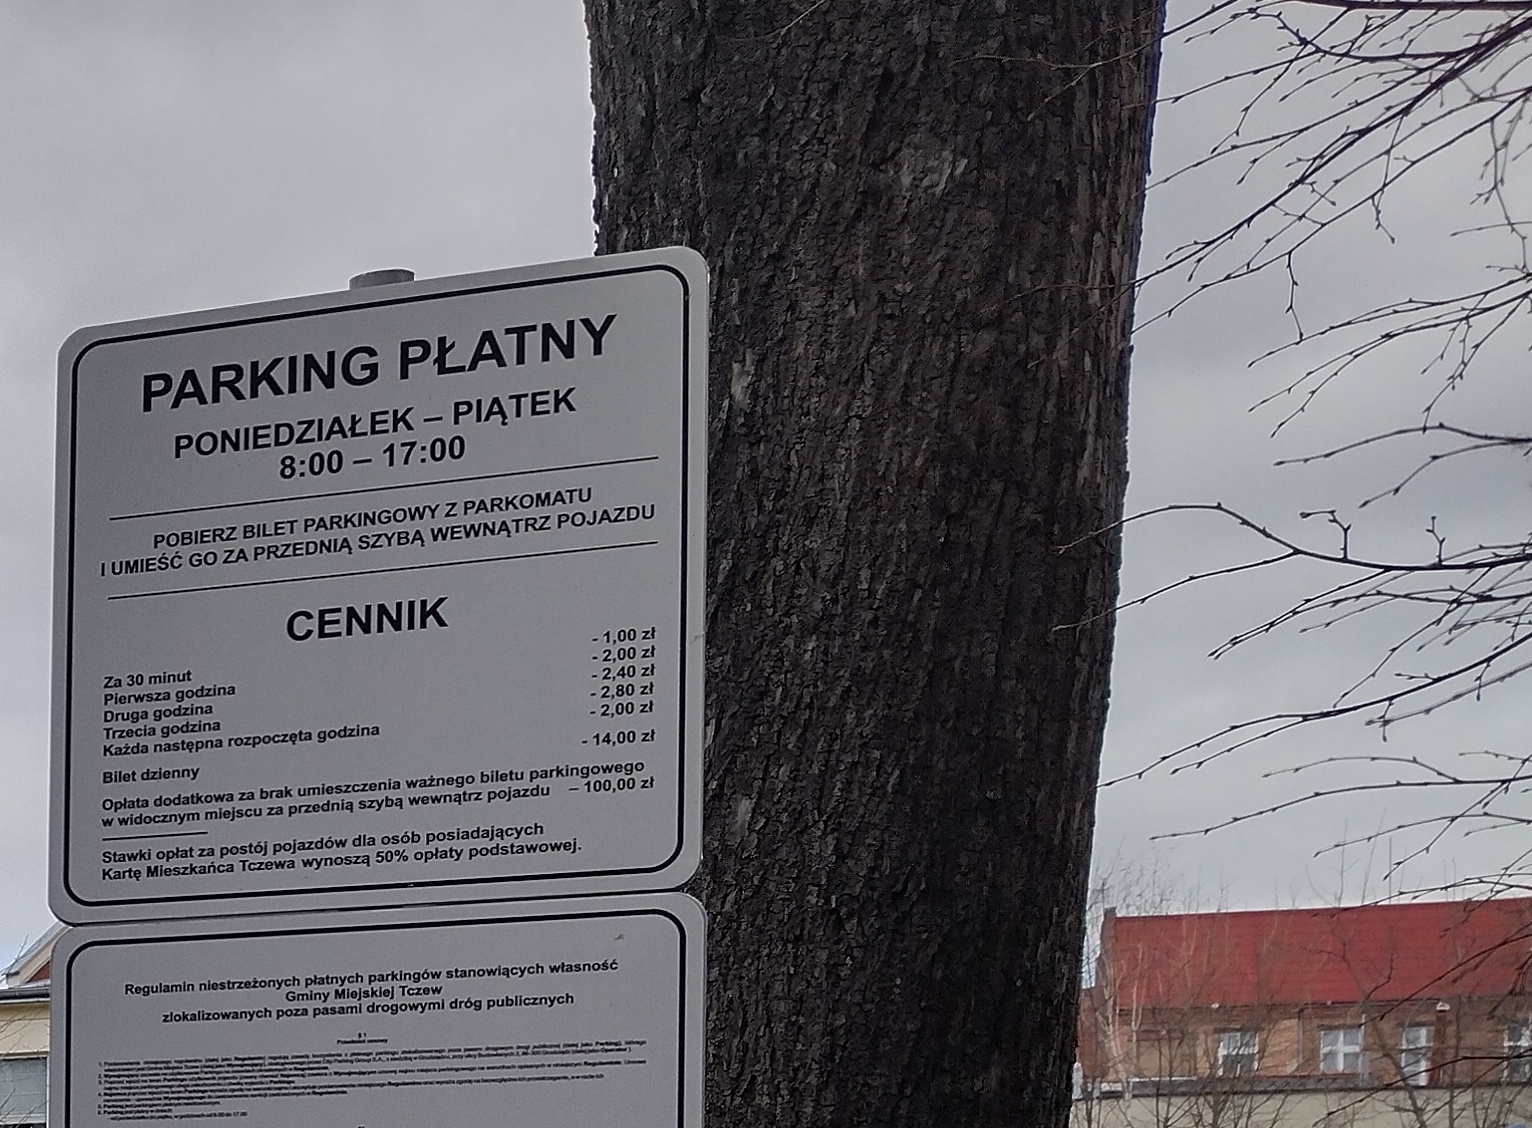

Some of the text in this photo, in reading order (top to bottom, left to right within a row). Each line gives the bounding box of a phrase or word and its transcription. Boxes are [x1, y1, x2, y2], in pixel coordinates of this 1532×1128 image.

[142, 313, 617, 412] PARKING PŁATNY
[174, 386, 576, 458] PONIEDZIAŁEK PIĄTEK
[279, 435, 465, 479] 8:00 17:00
[153, 487, 591, 549] POBIERZ BILET PARKINGOWY Z PARKOMATU
[100, 503, 654, 576] I UMIEŚĆ GO ZA PRZEDNIĄ SZYBĄ WEWNĄTRZ POJAZDU
[286, 596, 448, 641] CENNIK
[603, 626, 656, 645] 1,00 zł
[602, 644, 655, 663] 2,00 zł
[103, 670, 192, 689] Za 30 minut
[601, 663, 655, 681] 2,40 zł
[104, 684, 235, 705] Pierwsza godzina
[600, 681, 654, 700] 2,80 zł
[103, 703, 213, 723] Druga godzina
[600, 699, 654, 718] 2,00 zł
[102, 720, 220, 739] Trzecia godzina
[103, 724, 379, 756] Każda następna rozpoczęta godzina
[592, 728, 655, 746] 14,00 zł
[101, 762, 644, 812] Opłata dodatkowa za brak umieszczenia ważnego biletu parkingowego
[102, 767, 200, 783] Bilet dzienny
[101, 775, 654, 827] w widocznym miejscu za przednią szybą wewnątrz pojazdu 100,00 zł
[101, 822, 543, 863] Stawki opłat za postój pojazdów dla osób posiadających
[102, 837, 581, 881] Kartę Mieszkańca Tczewa wynoszą 50% opłaty podstawowej.
[124, 958, 618, 996] Regulamin niestrzeżonych płatnych parkingów stanowiących własność
[162, 992, 574, 1023] zlokalizowanych poza pasami drogowymi dróg publicznych
[285, 984, 442, 1003] Gminy Miejskiej Tczew
